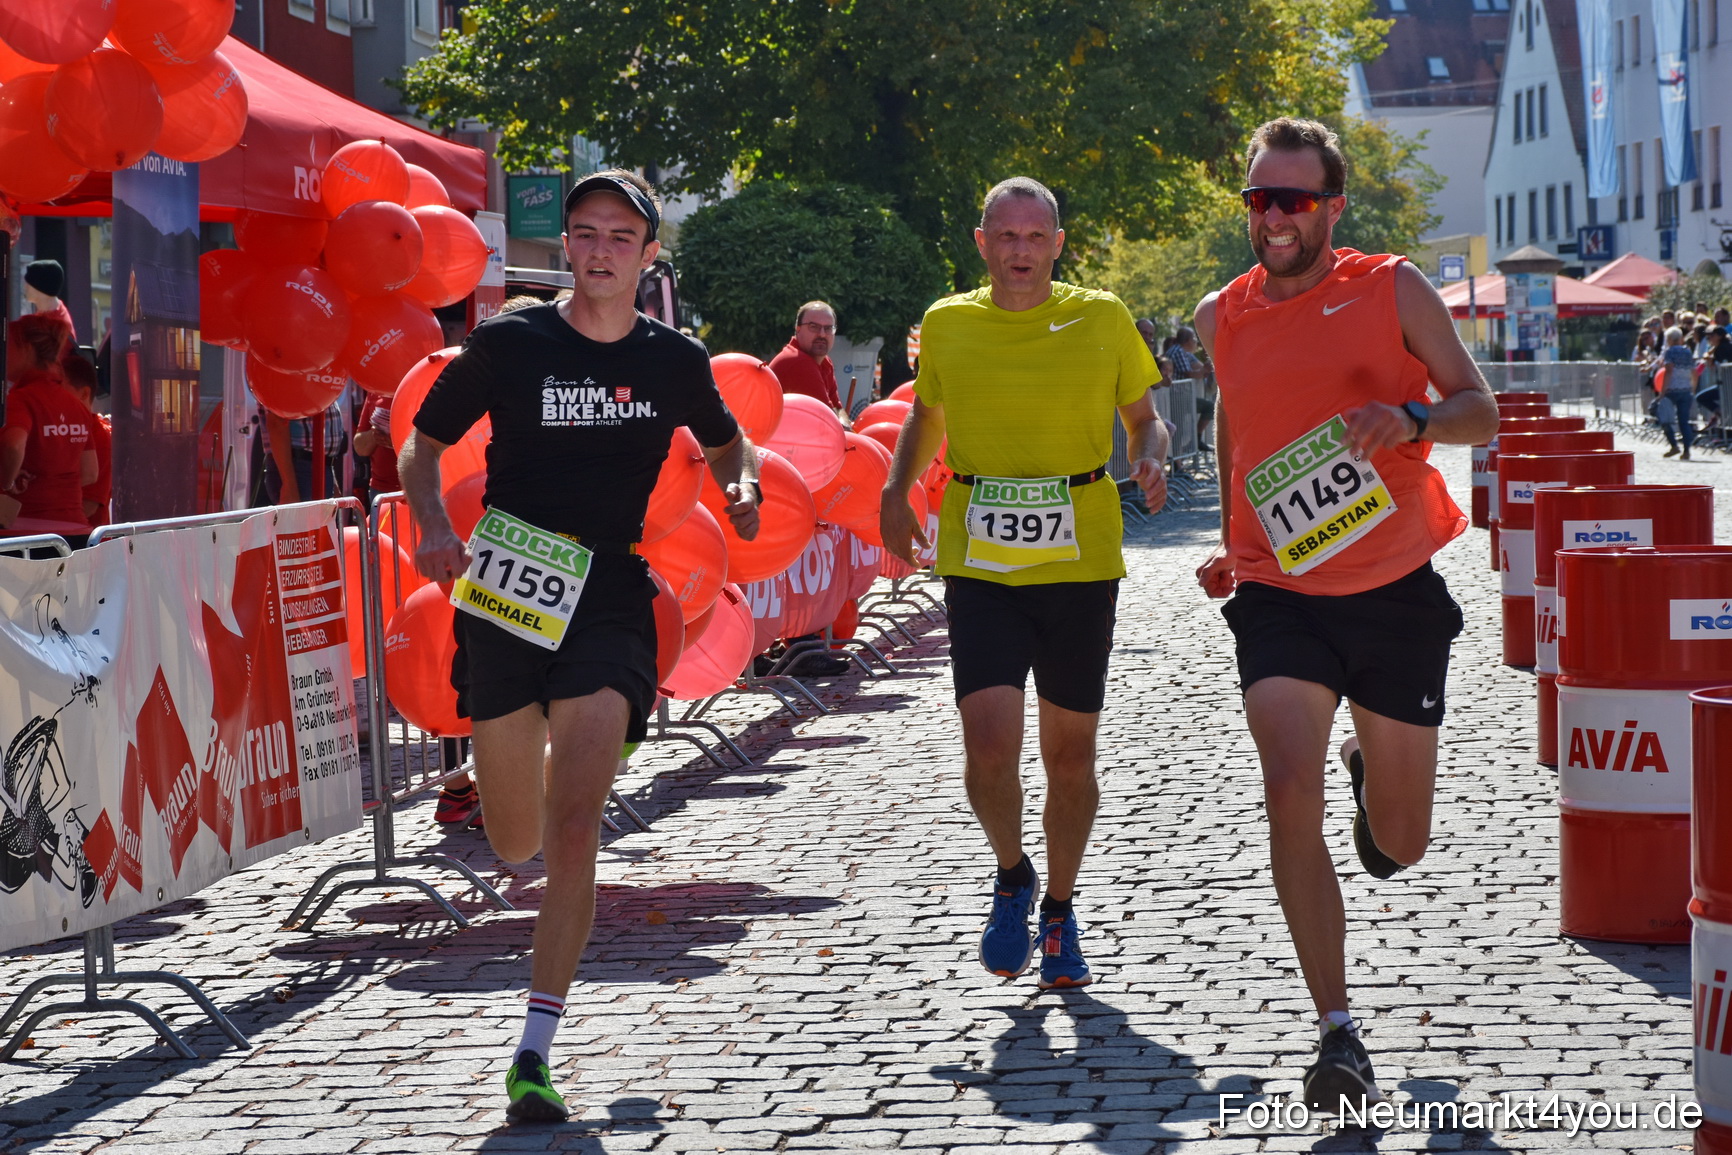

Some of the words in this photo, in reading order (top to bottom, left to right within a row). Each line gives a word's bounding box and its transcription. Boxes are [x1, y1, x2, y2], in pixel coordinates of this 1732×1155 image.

[143, 156, 160, 173] von
[524, 190, 553, 208] FASS
[541, 375, 578, 387] Born
[583, 377, 597, 385] to
[541, 387, 614, 404] SWIM.
[542, 401, 657, 420] BIKE.RUN.
[1249, 426, 1340, 500] BOCK
[980, 482, 1063, 504] BOCK
[1271, 462, 1361, 534] 1149
[981, 512, 1061, 543] 1397
[1288, 496, 1379, 561] SEBASTIAN
[483, 514, 580, 571] BOCK
[478, 549, 565, 607] 1159
[469, 588, 543, 631] MICHAEL
[291, 674, 313, 690] Braun
[294, 695, 306, 711] Am
[301, 744, 316, 761] Tel.
[317, 738, 335, 757] 09181
[304, 766, 319, 782] Fax
[321, 758, 338, 778] 09181
